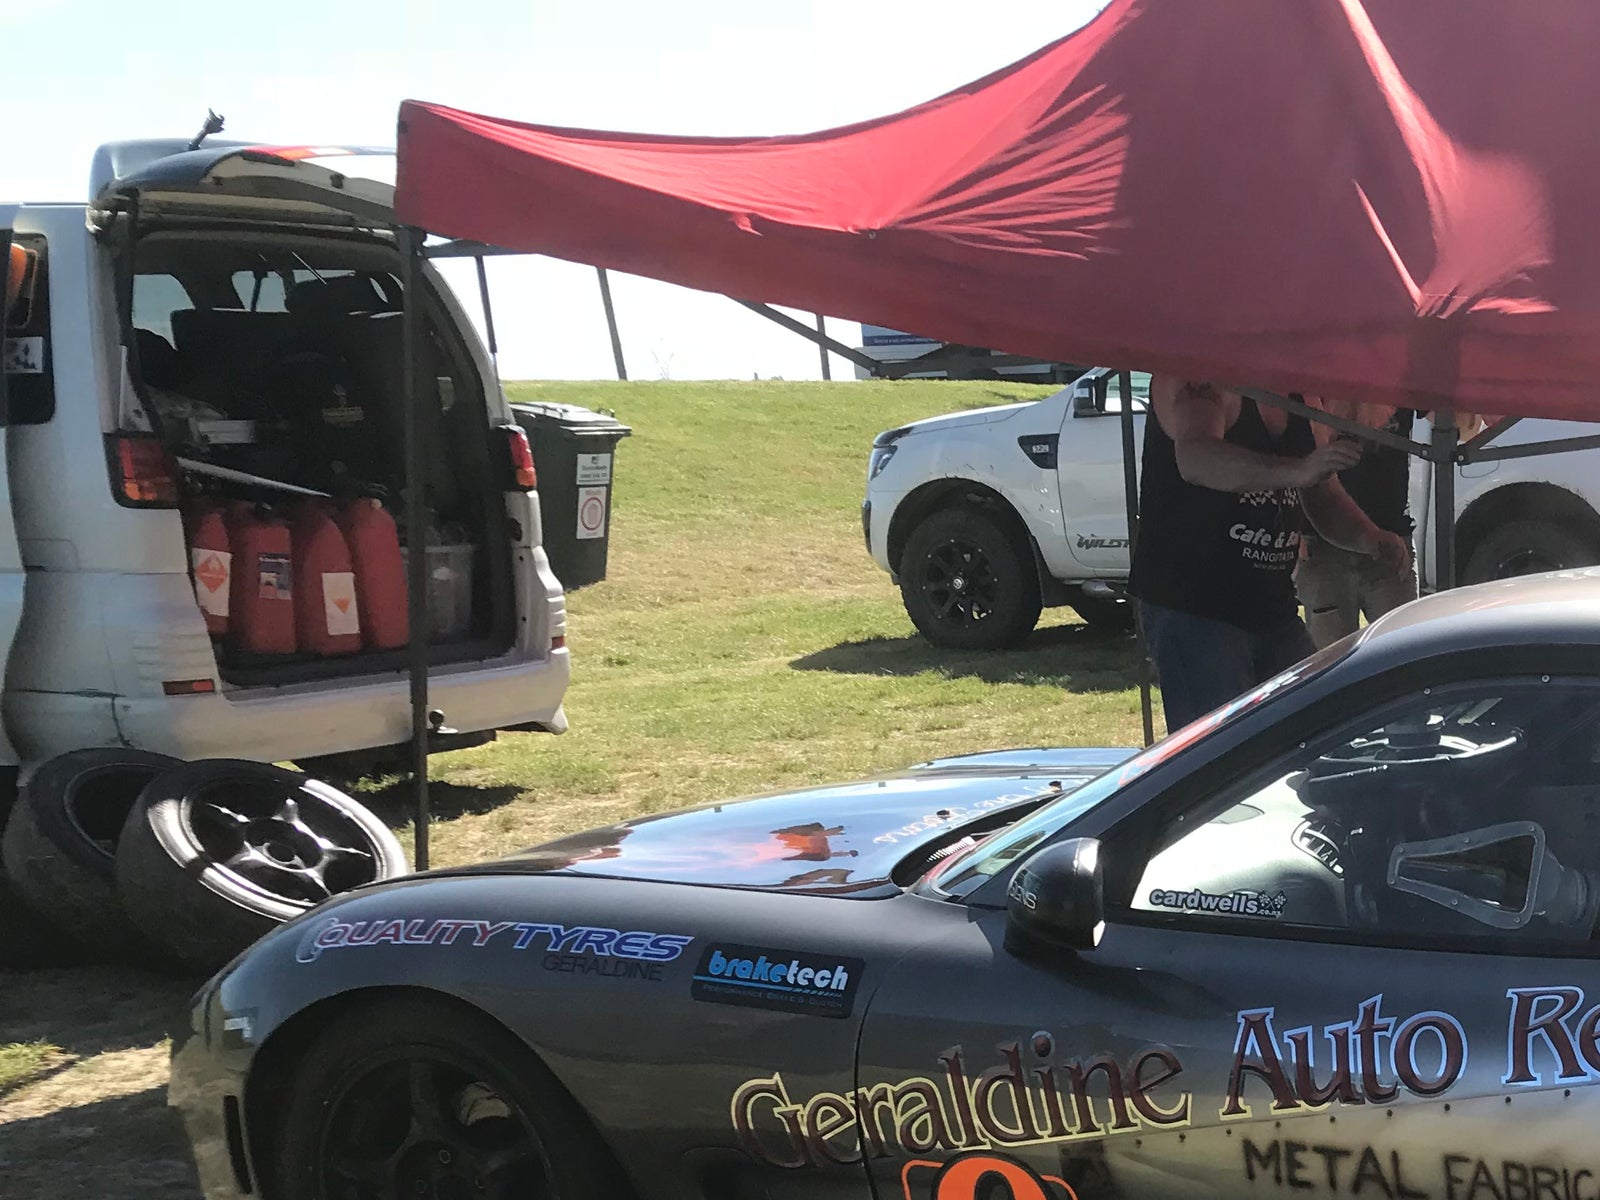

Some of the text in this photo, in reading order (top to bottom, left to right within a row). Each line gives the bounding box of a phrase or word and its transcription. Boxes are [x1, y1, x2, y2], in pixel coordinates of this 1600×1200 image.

[1229, 523, 1272, 546] Cafe
[1274, 531, 1286, 548] &
[1149, 888, 1258, 915] cardwells
[314, 919, 694, 962] QUALITY TYRES
[541, 953, 665, 982] GERALDINE
[708, 950, 849, 991] braketech
[731, 1029, 1193, 1168] Geraldine
[1219, 994, 1468, 1120] Auto
[1241, 1137, 1429, 1200] METAL
